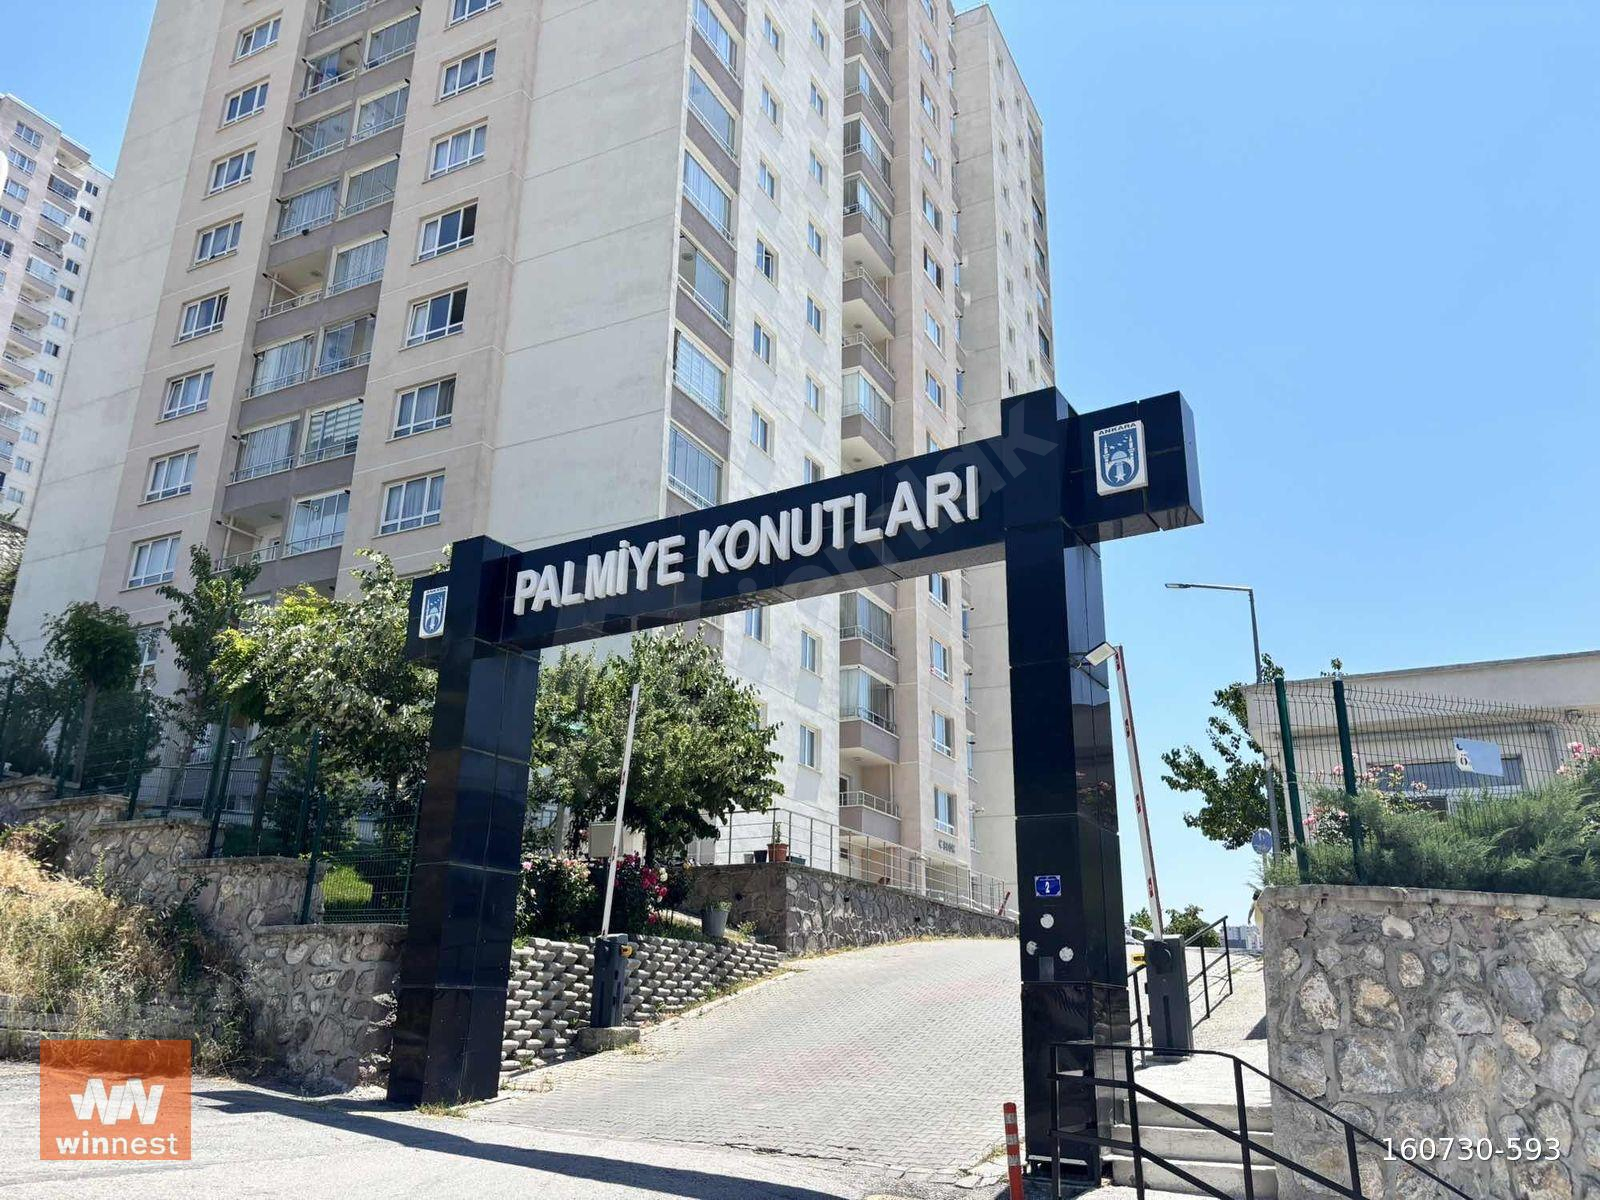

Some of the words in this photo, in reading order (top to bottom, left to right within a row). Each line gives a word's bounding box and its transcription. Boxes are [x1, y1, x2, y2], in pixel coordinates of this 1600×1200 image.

[1098, 422, 1137, 436] ANKARA
[512, 533, 686, 616] PALMİYE
[696, 464, 980, 579] KONUTLARI
[1045, 881, 1051, 894] 2
